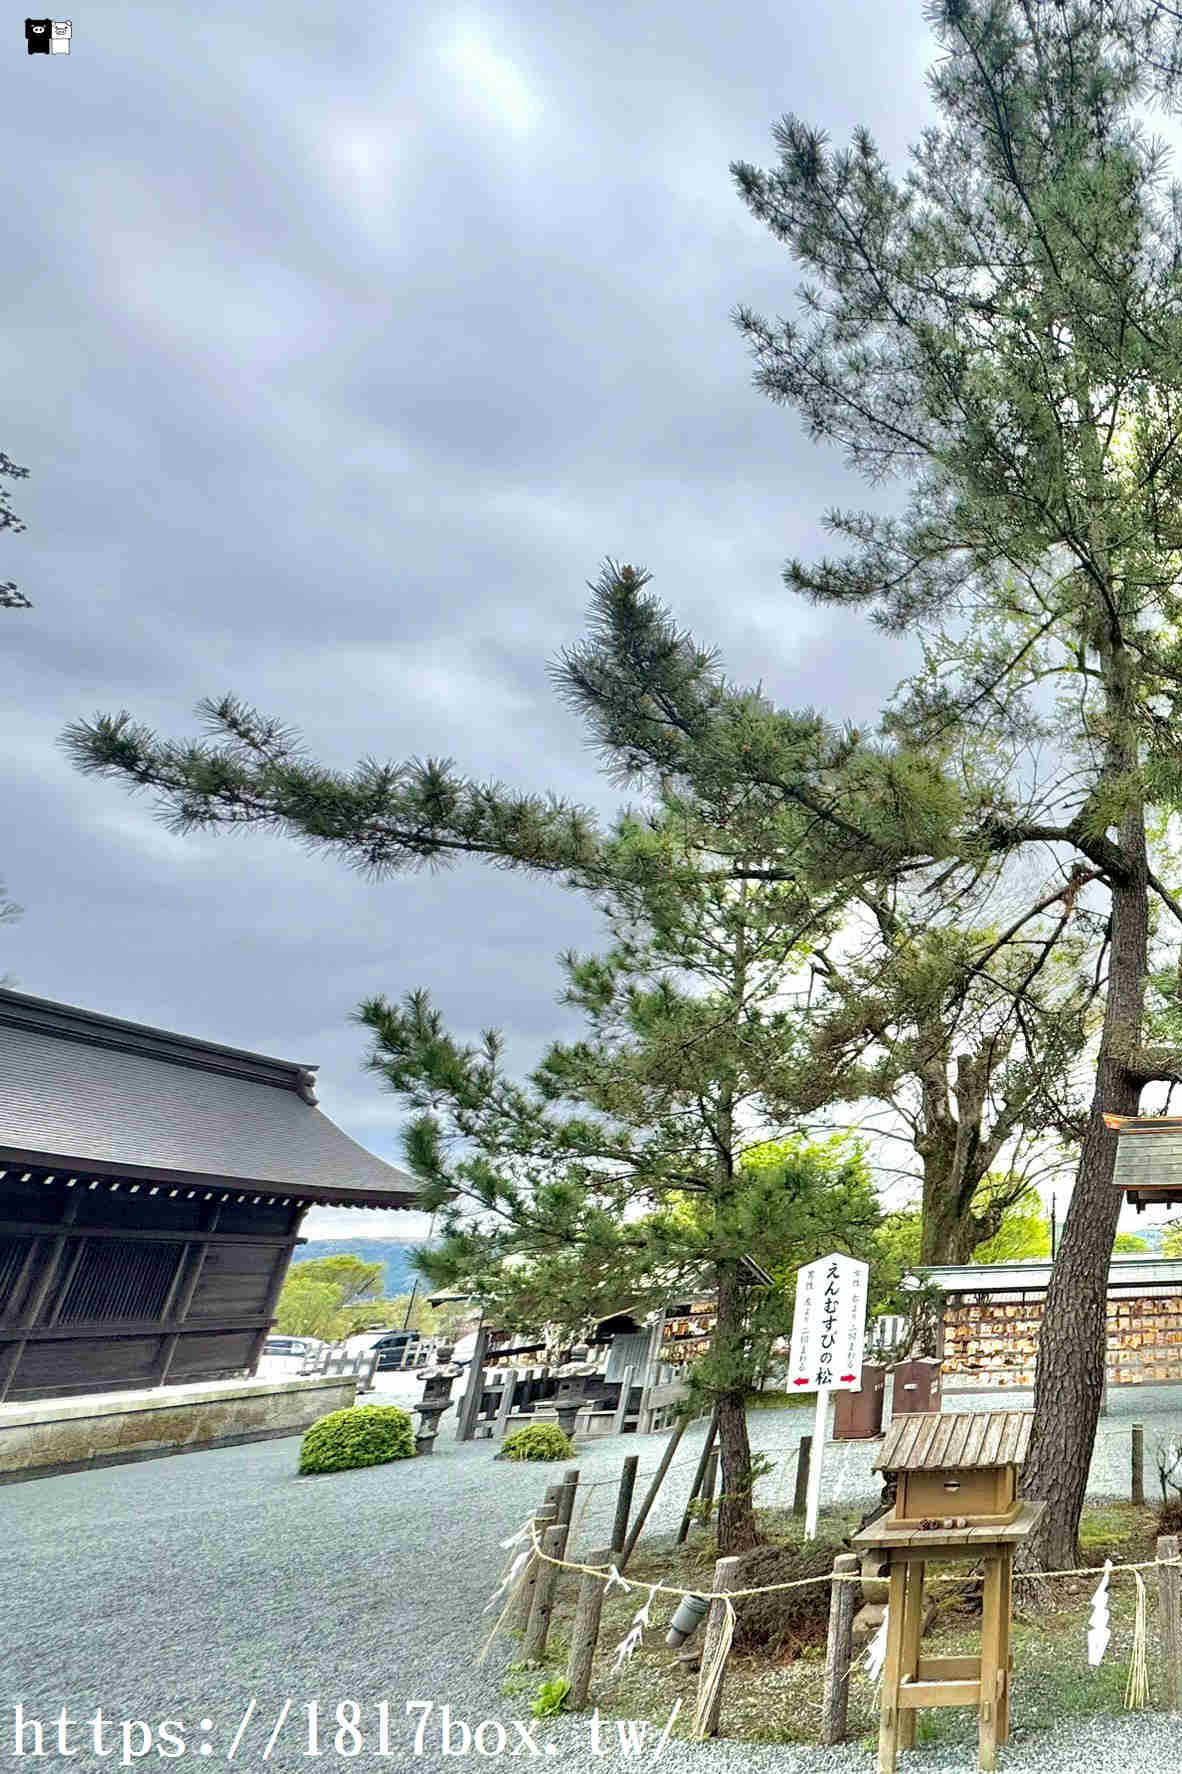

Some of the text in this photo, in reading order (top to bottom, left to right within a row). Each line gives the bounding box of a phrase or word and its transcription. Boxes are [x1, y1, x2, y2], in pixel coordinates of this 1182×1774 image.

[816, 1262, 840, 1386] えんむすびの松
